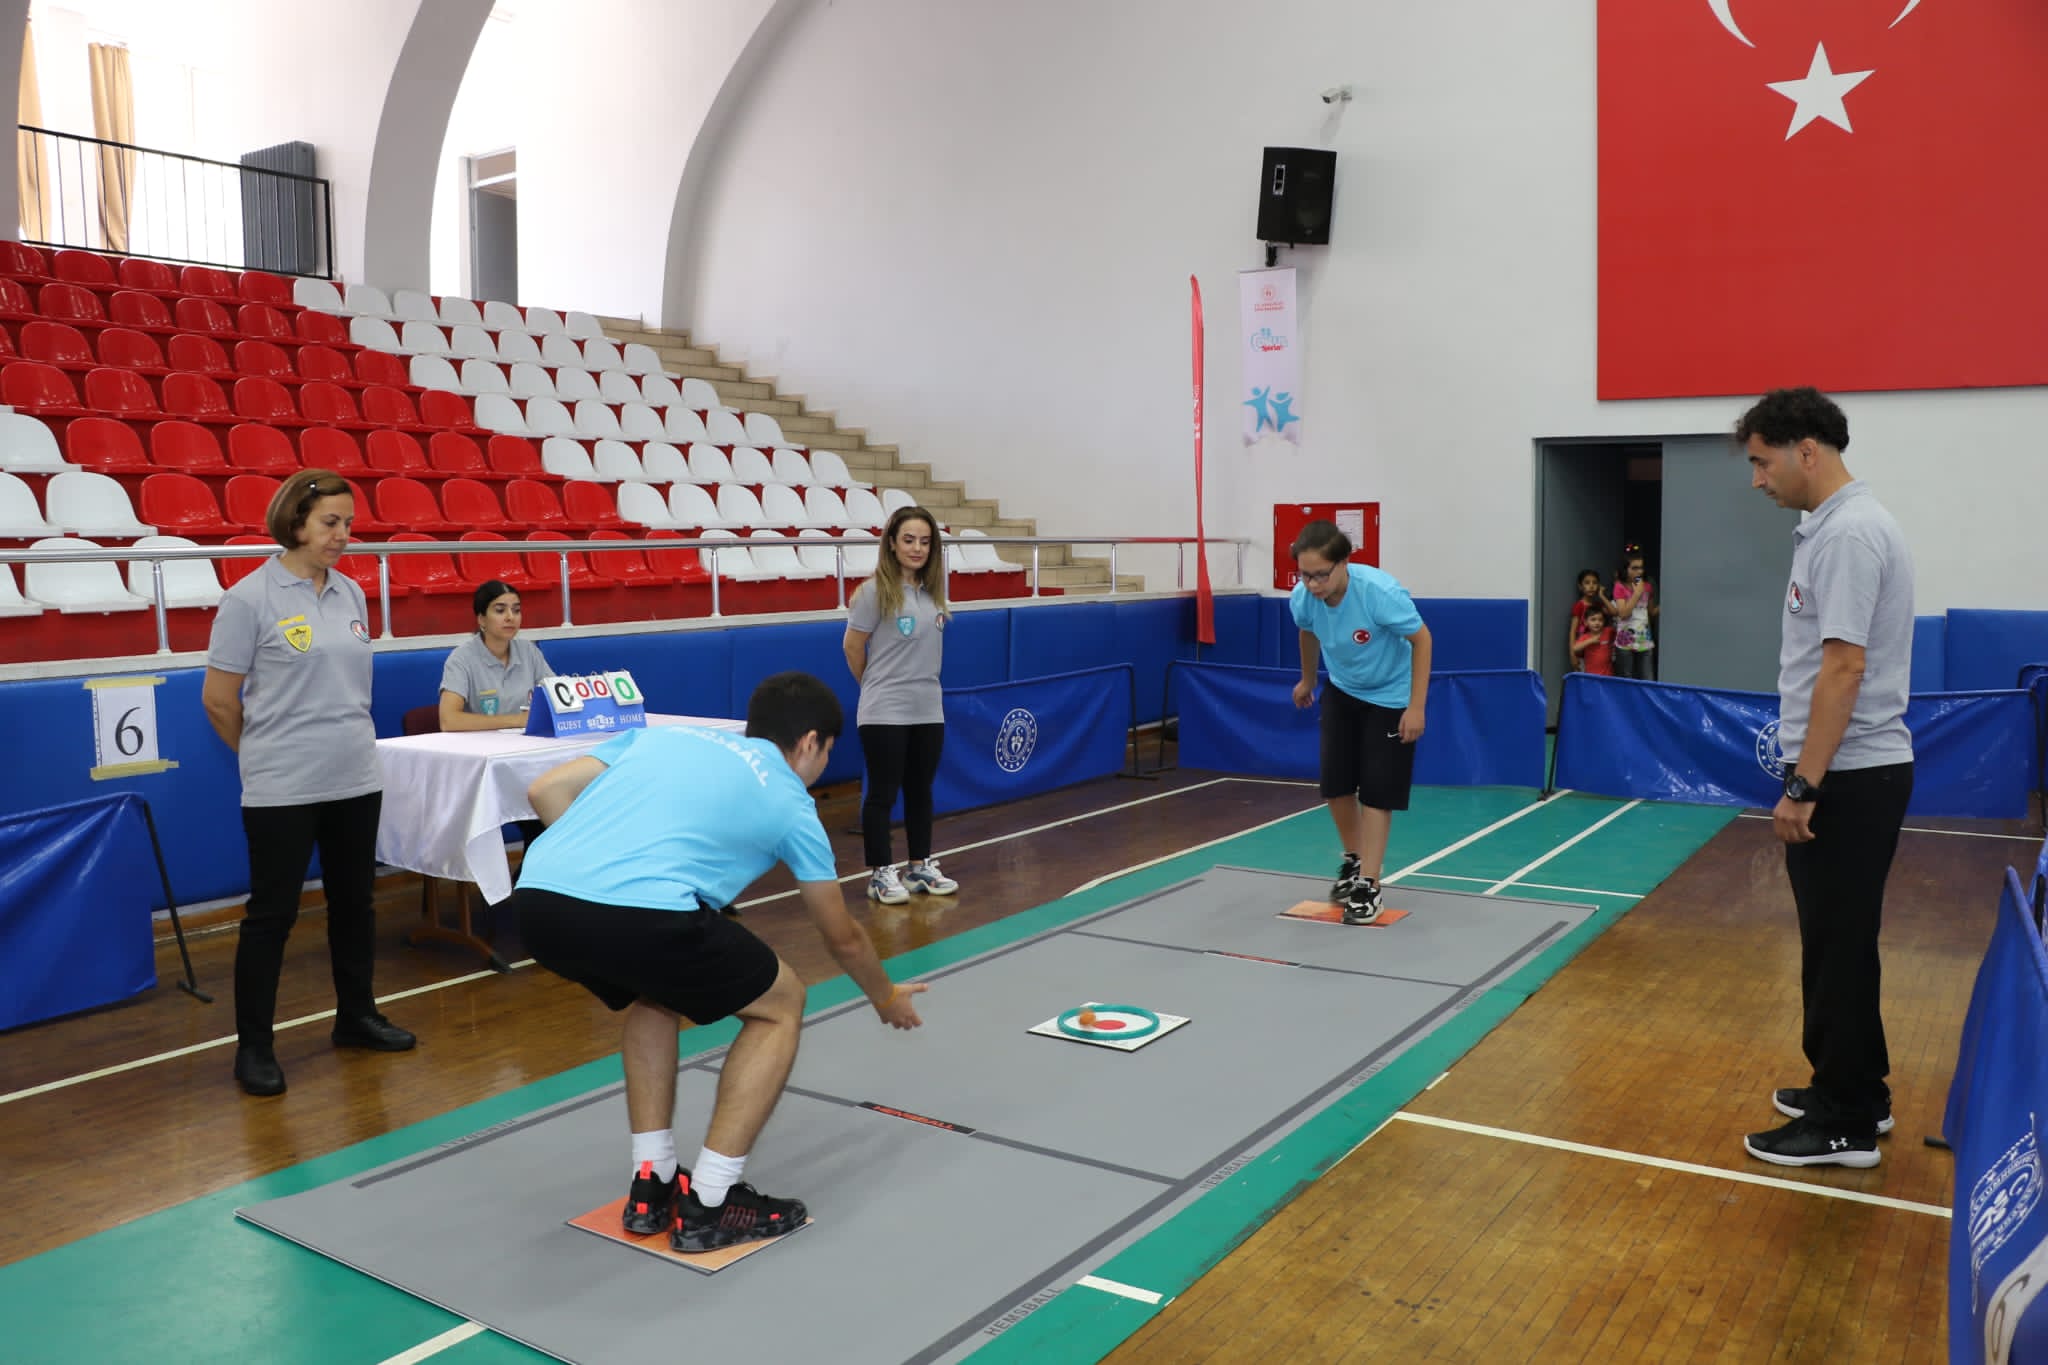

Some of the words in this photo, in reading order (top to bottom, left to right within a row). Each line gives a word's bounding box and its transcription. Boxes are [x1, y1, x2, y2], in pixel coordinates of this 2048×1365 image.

[115, 706, 144, 756] 6
[557, 720, 582, 731] GUEST
[619, 713, 643, 724] HOME
[984, 1287, 1061, 1337] HEMSBALL
